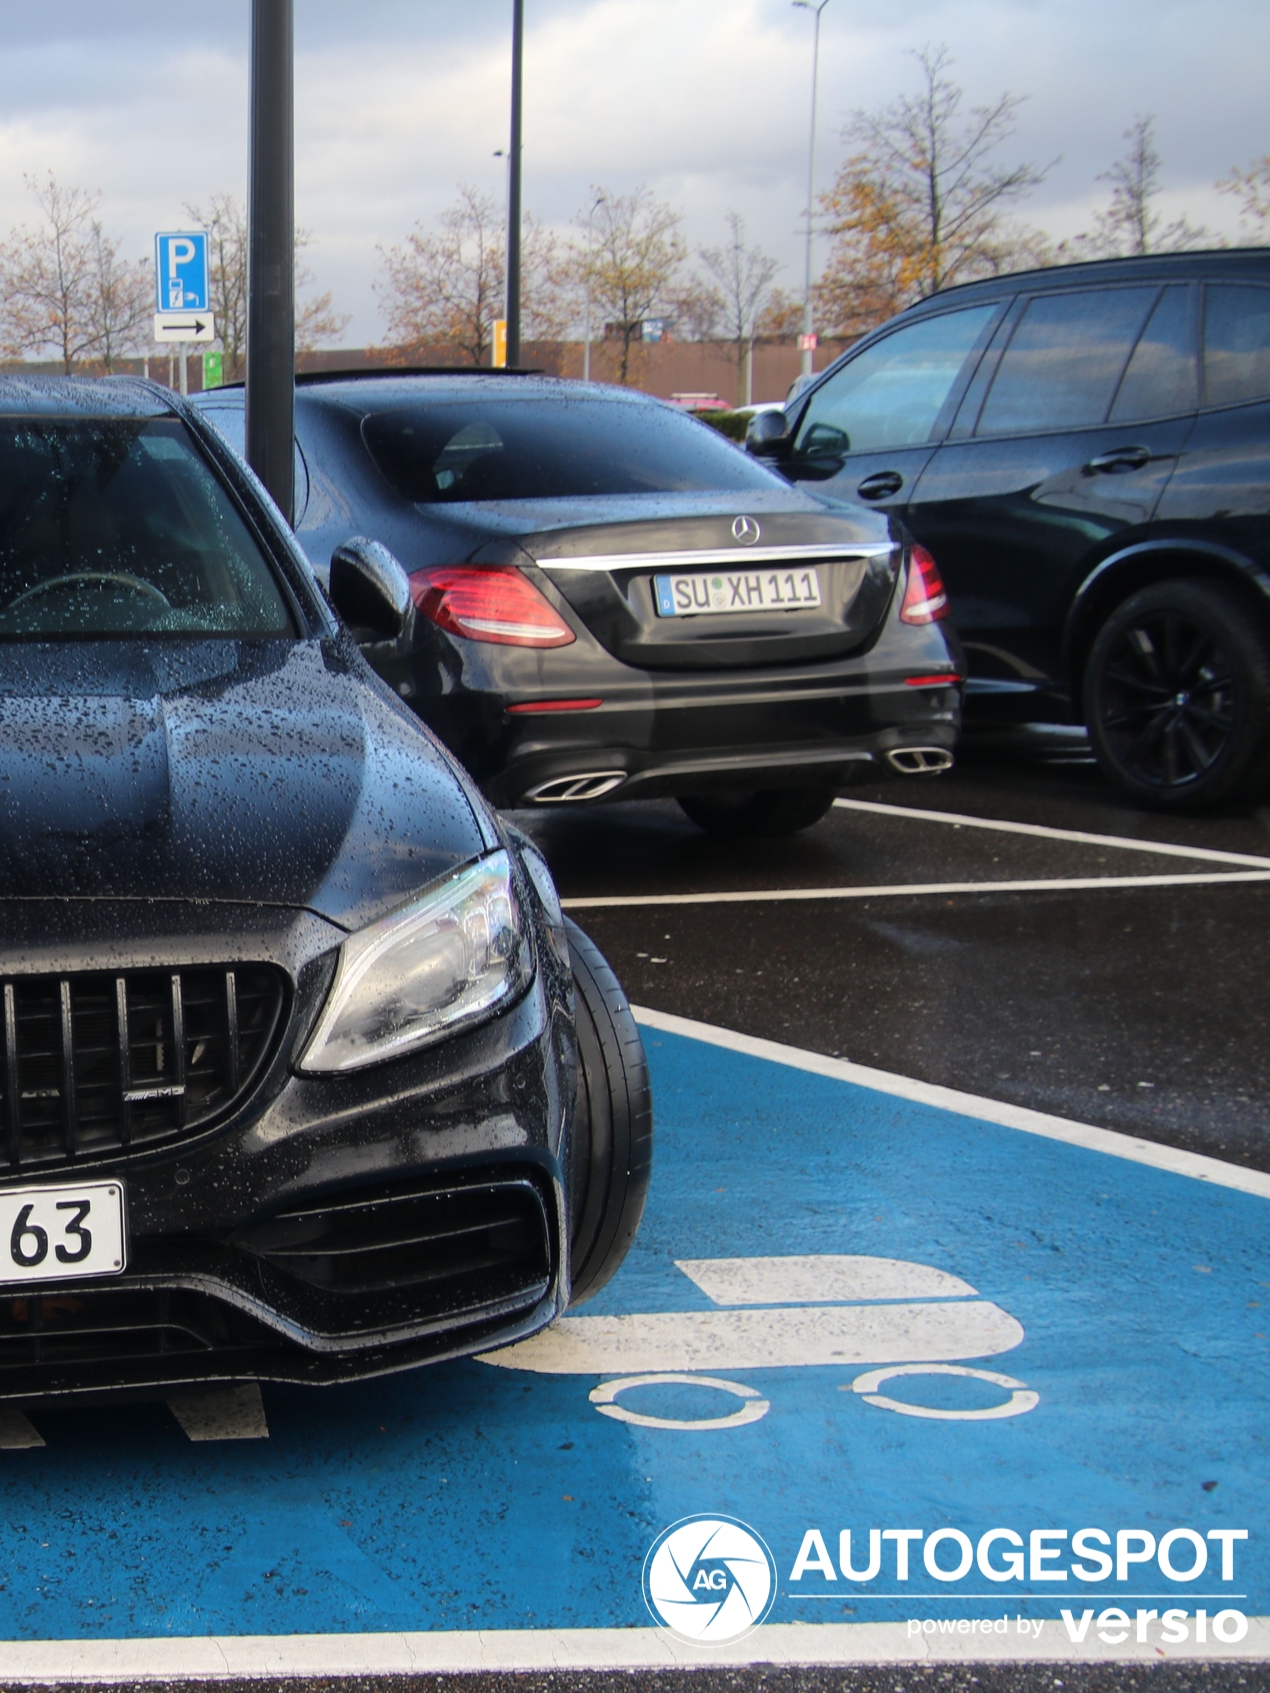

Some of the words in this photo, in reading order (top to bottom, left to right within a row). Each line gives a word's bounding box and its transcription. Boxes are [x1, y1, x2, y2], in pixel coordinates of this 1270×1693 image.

[167, 237, 196, 278] P
[674, 578, 711, 608] SU
[727, 575, 764, 606] XH
[768, 572, 818, 604] 111
[10, 1199, 92, 1267] 63
